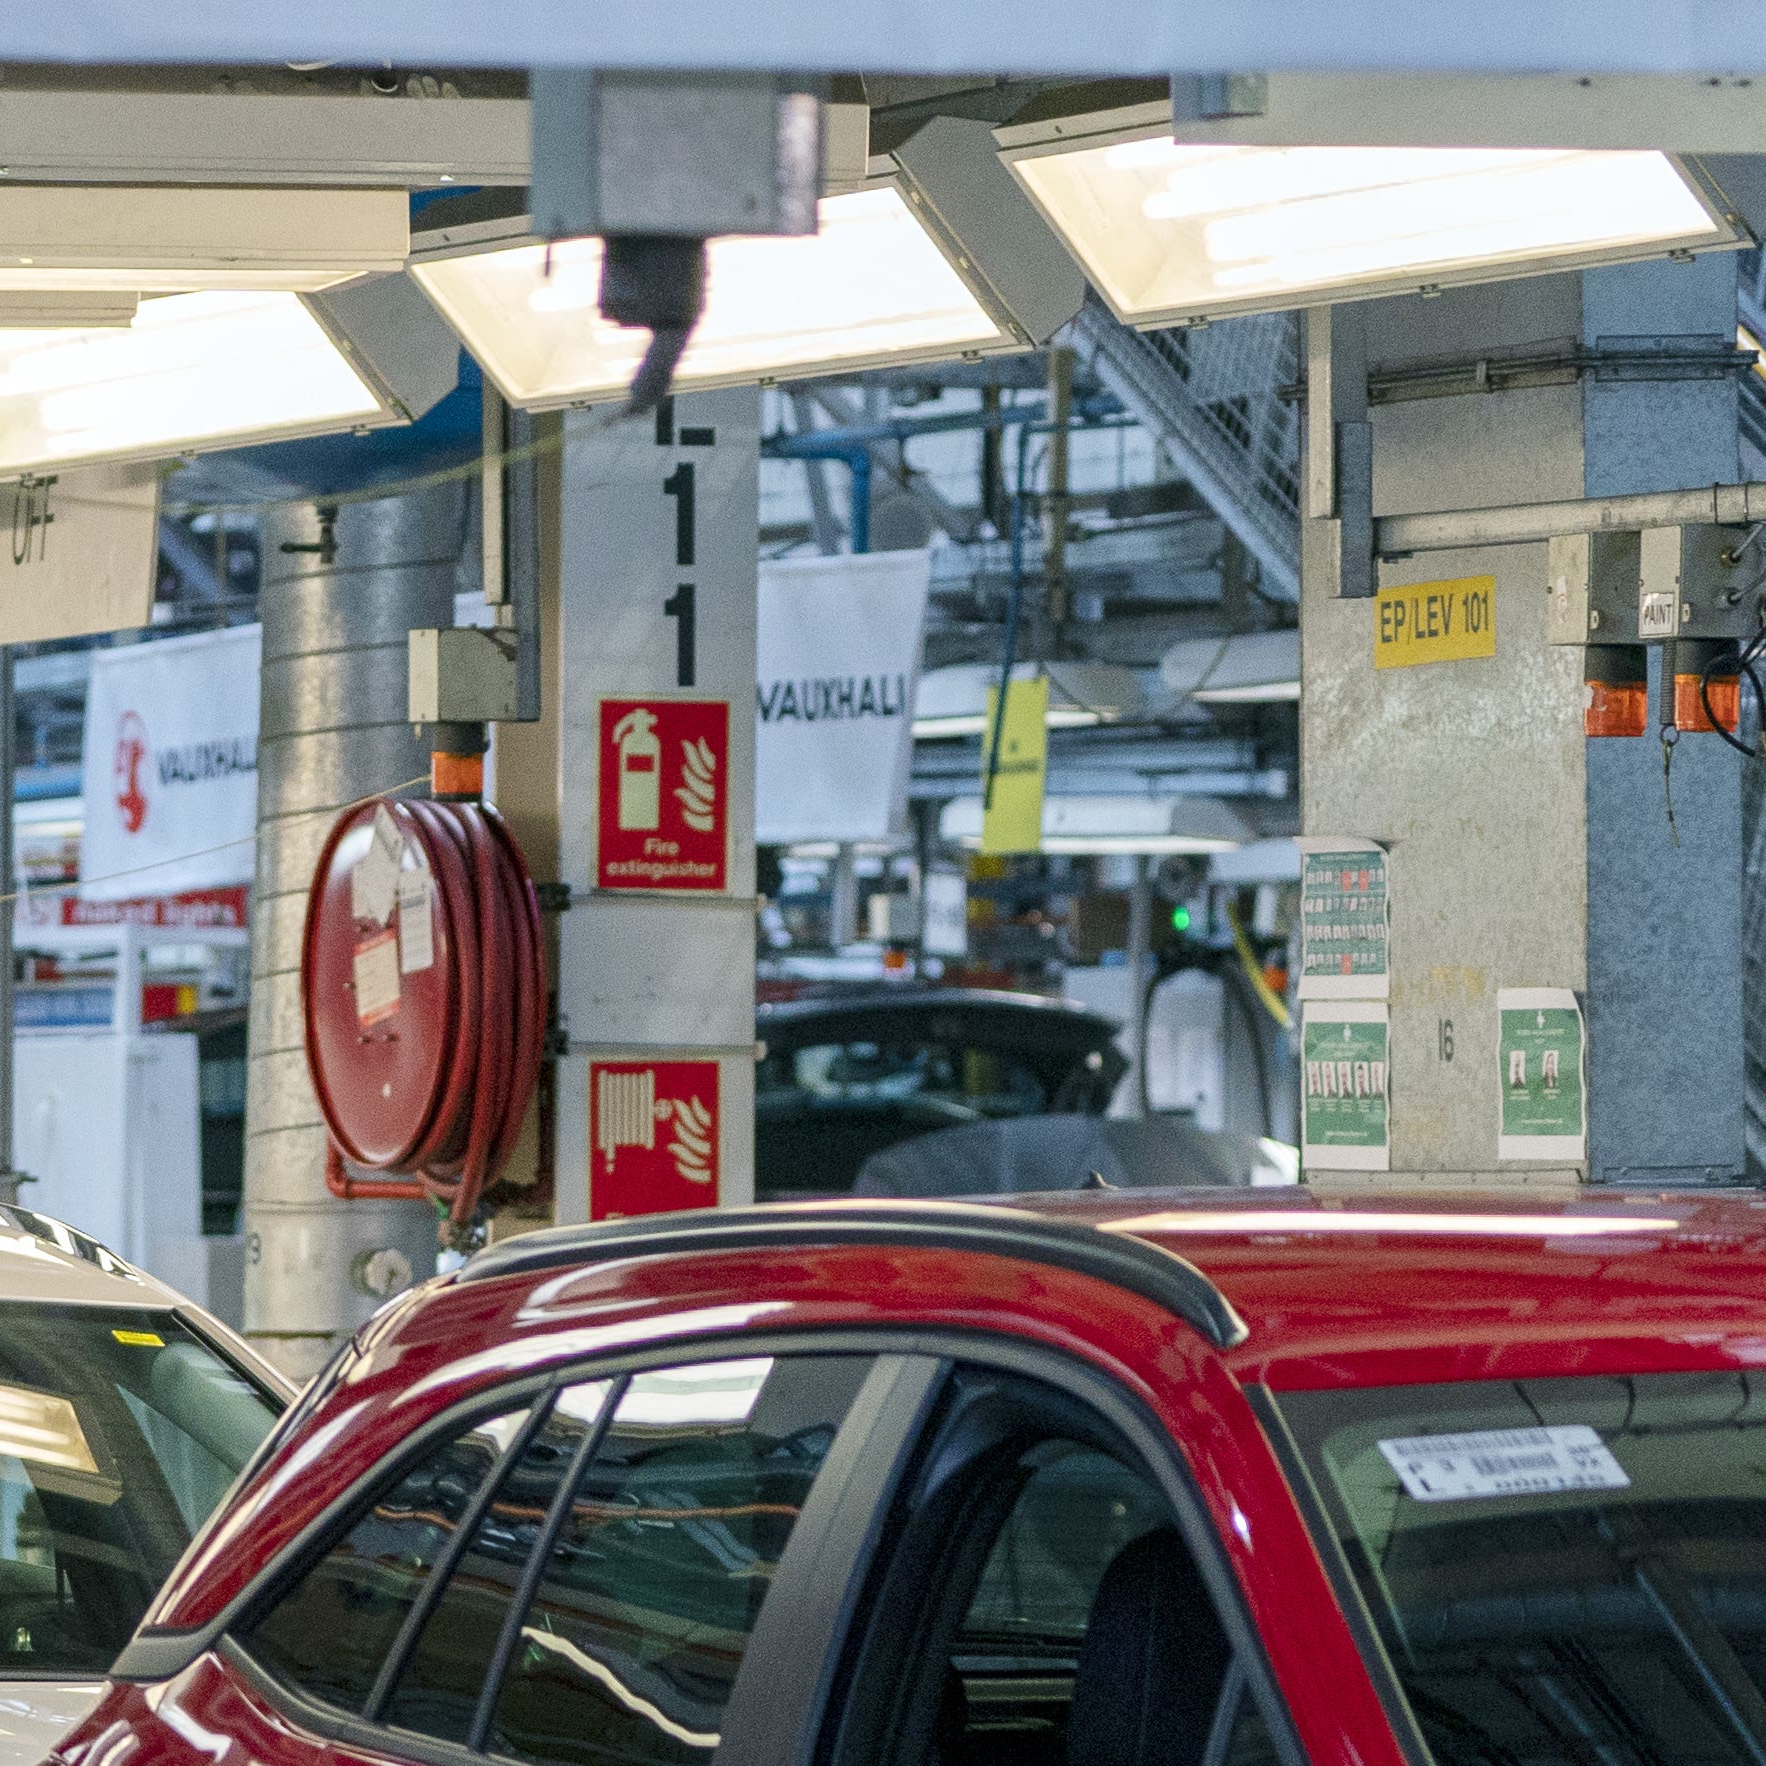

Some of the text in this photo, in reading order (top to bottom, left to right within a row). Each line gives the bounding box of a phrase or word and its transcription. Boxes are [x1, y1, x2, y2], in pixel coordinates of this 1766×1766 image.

[1381, 590, 1488, 645] EP/LEV 101
[1644, 603, 1672, 626] PAINT
[156, 734, 257, 785] VAUXHAL
[644, 837, 680, 856] Fire
[606, 860, 717, 881] extinguisher
[1437, 1016, 1455, 1062] 16
